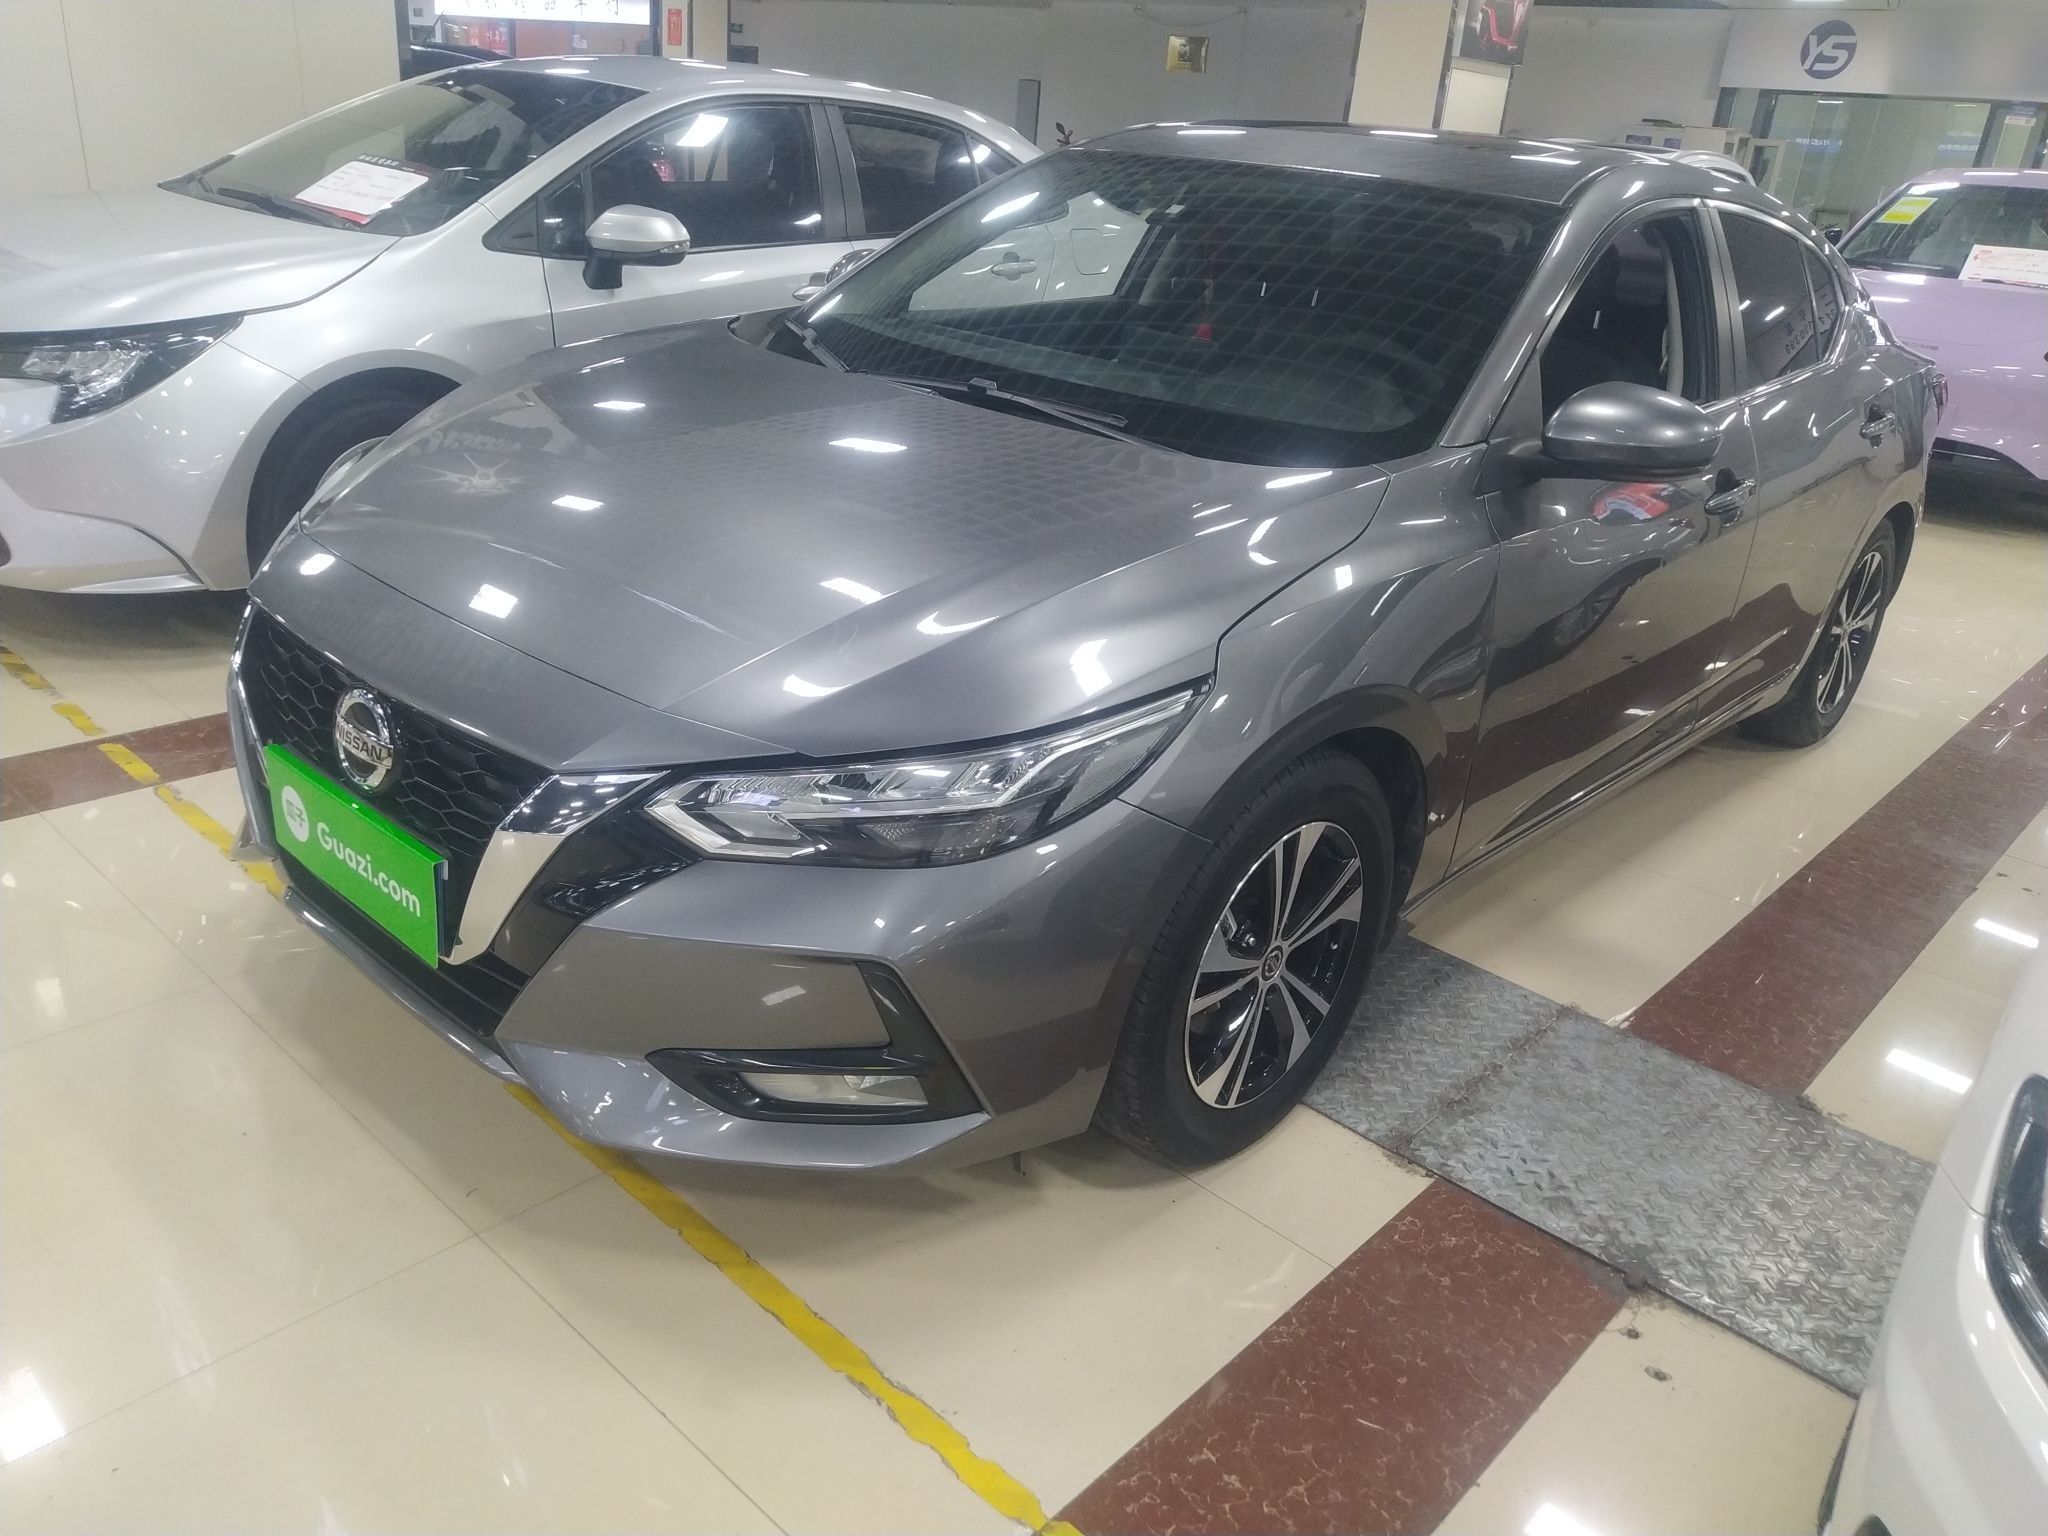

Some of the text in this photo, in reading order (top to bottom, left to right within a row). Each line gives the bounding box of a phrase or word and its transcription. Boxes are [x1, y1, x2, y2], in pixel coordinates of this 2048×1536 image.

[1803, 34, 1858, 71] YS
[338, 723, 383, 763] NISSAN
[317, 822, 421, 917] Guazi.com
